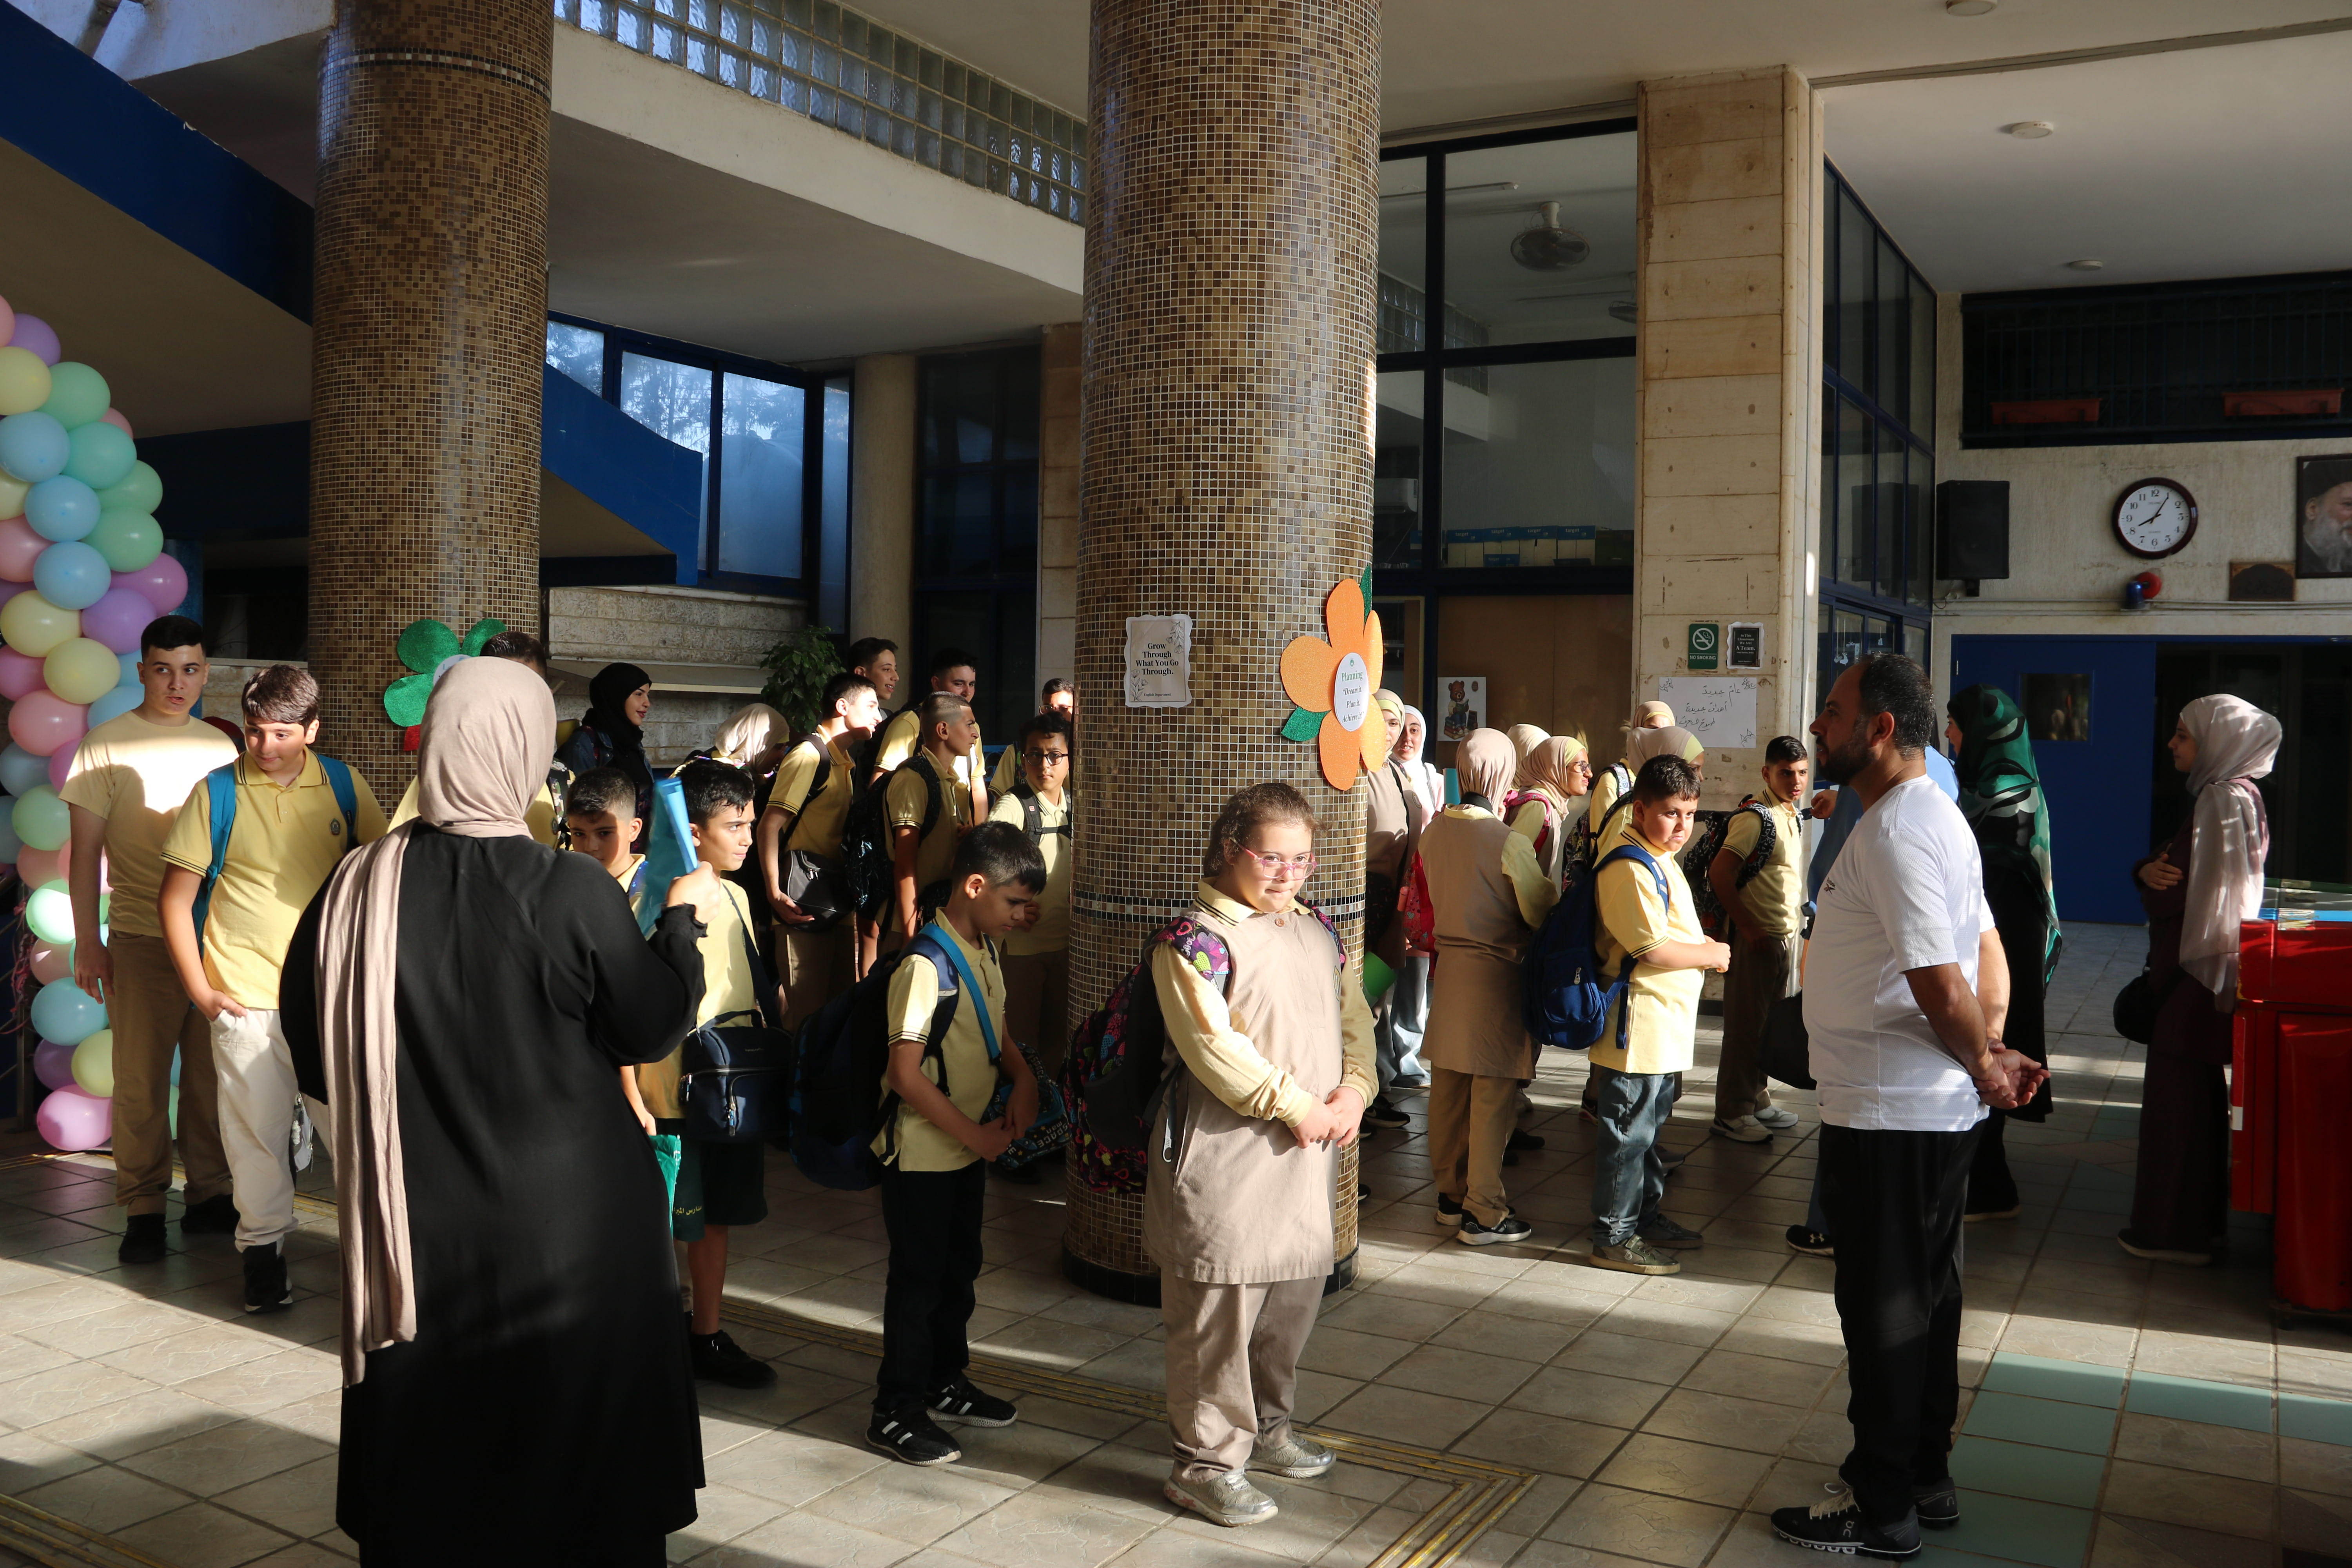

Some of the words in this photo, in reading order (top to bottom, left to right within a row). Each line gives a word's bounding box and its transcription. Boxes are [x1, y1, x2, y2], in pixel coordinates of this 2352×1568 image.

[1142, 651, 1172, 659] Through
[1342, 670, 1363, 682] Planning
[1342, 713, 1357, 723] Achieve
[1046, 1121, 1063, 1134] man
[1037, 1123, 1069, 1148] SPACE
